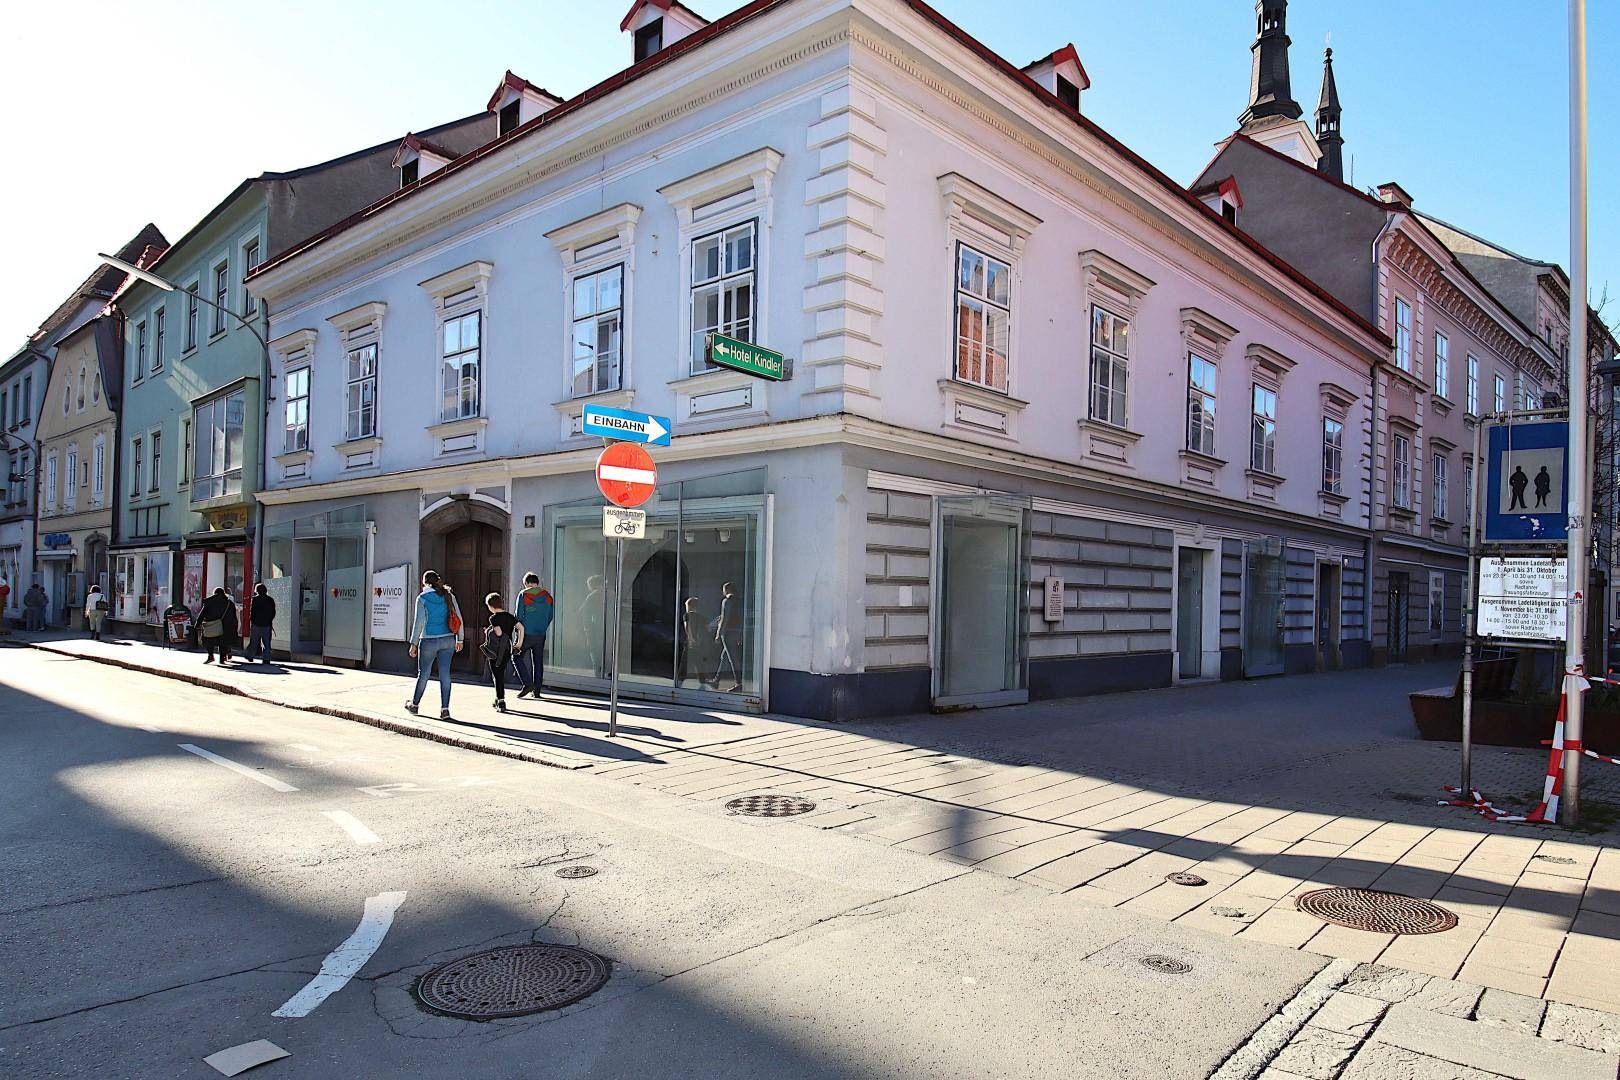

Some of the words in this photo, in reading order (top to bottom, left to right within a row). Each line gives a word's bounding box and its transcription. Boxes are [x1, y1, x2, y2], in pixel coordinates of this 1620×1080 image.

[730, 345, 751, 364] Hotel
[755, 353, 780, 372] Kindler
[594, 416, 645, 432] EINBAHN
